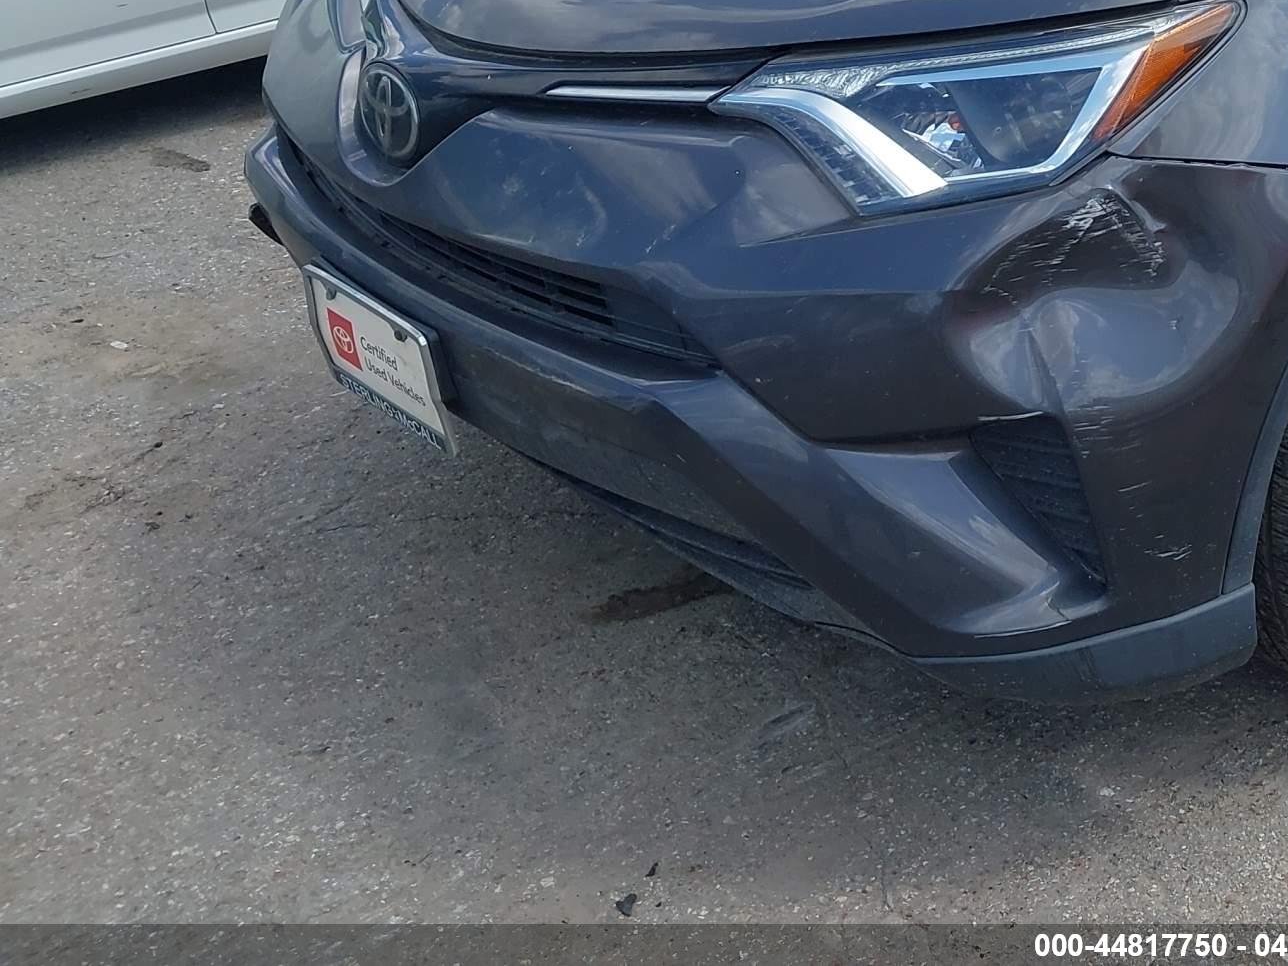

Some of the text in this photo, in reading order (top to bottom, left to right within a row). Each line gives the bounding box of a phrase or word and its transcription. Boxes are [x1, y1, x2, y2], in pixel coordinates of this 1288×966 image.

[360, 336, 398, 371] Certified
[340, 373, 394, 417] STERLING
[365, 357, 427, 407] Used Vehicles
